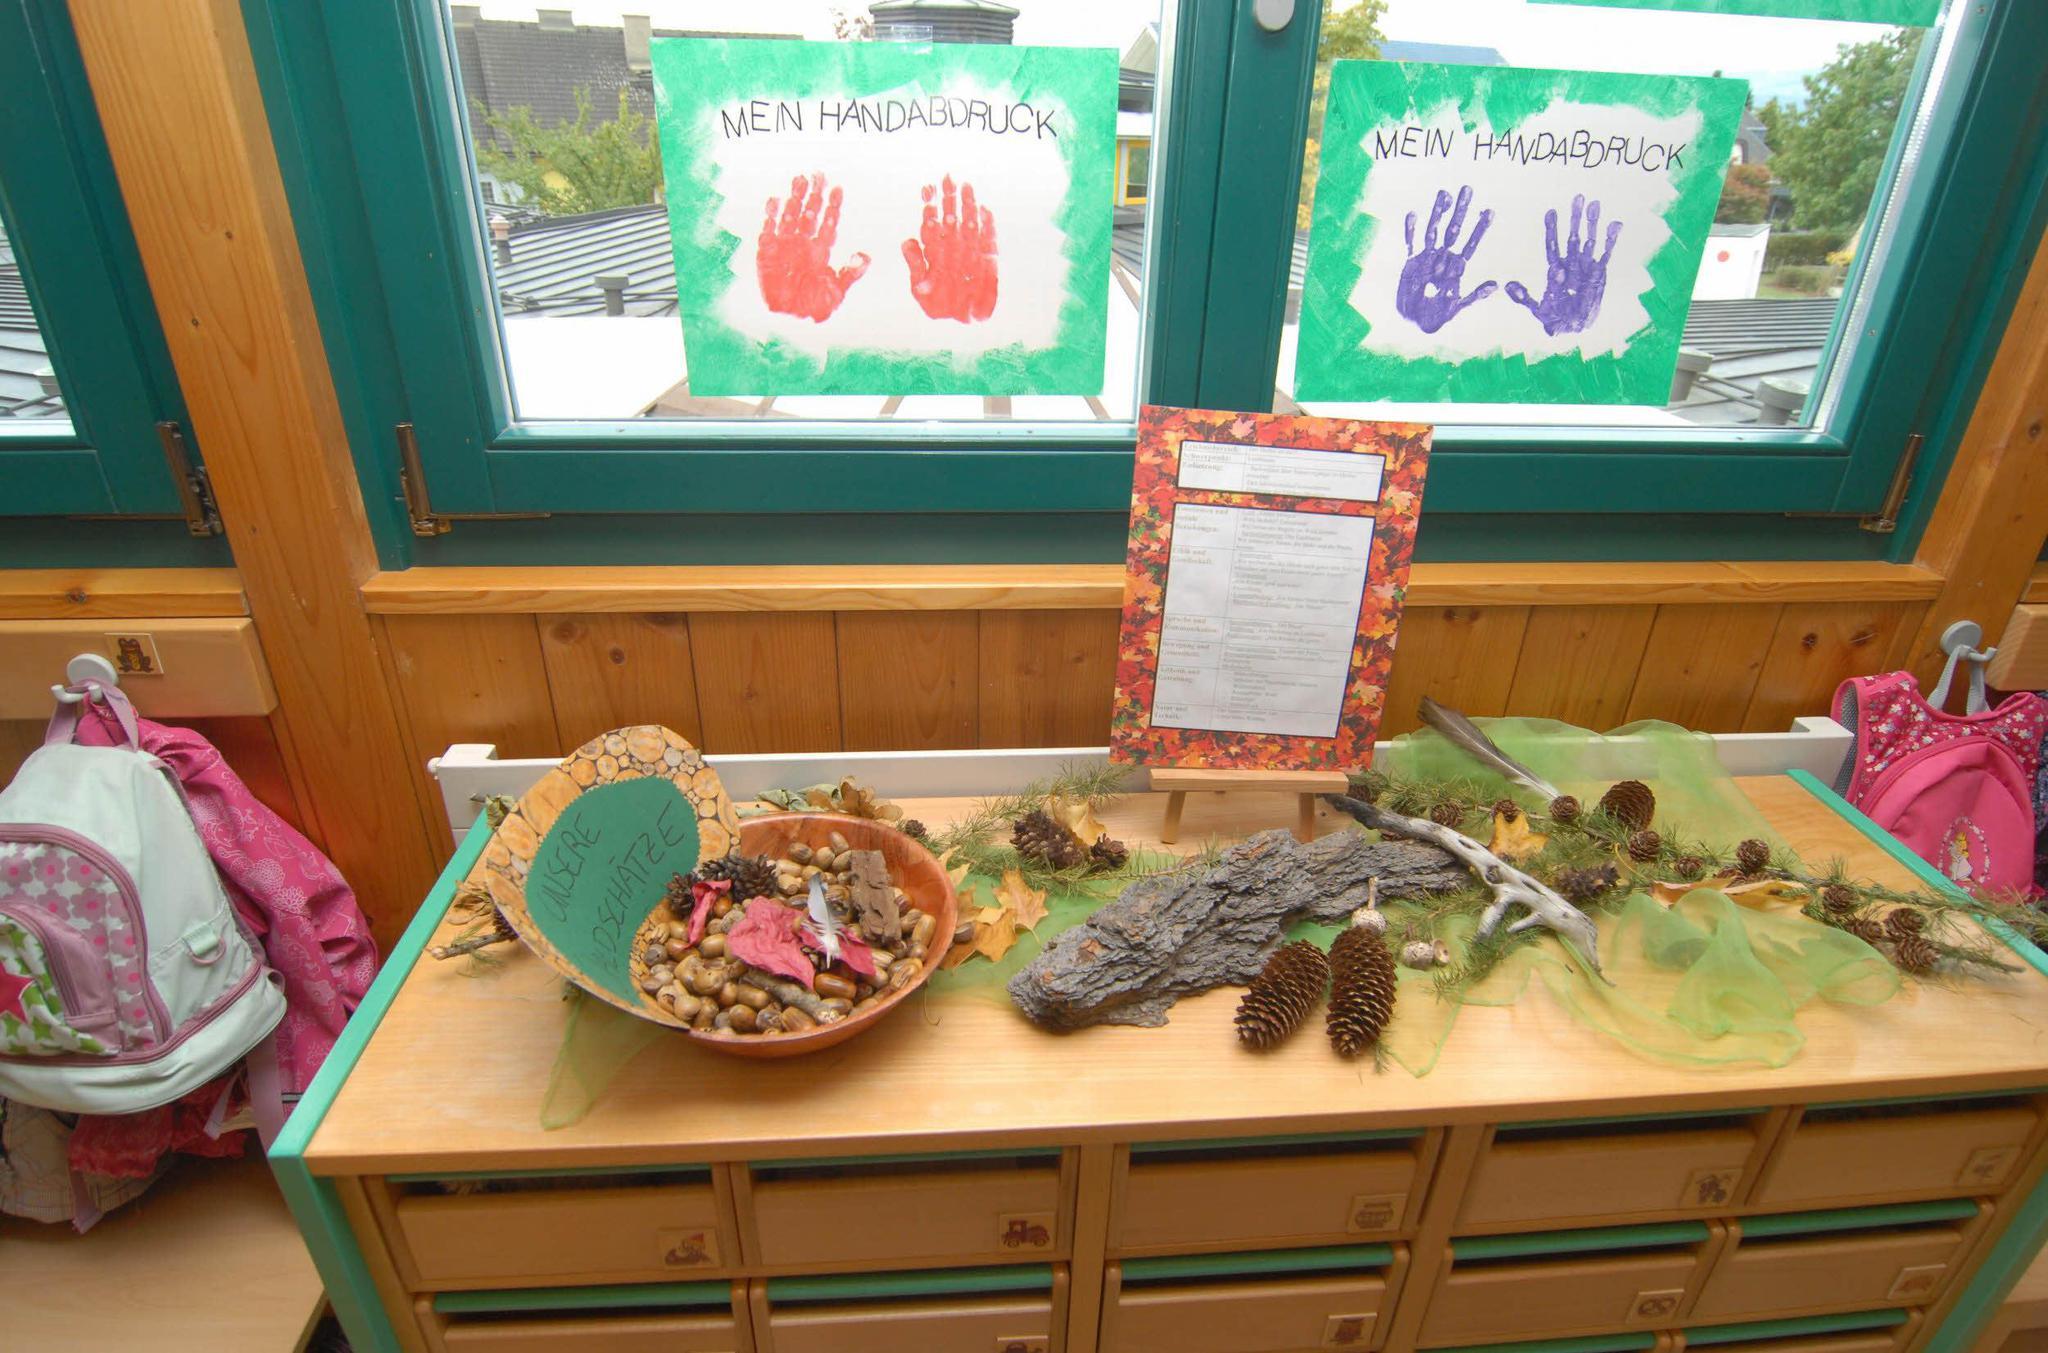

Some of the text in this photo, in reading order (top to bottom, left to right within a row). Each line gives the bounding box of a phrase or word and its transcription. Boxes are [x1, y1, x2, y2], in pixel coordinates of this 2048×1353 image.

[722, 95, 1058, 140] MEIN HANDABDRUCK
[1375, 127, 1687, 172] MEIN HANDABDRUCK
[542, 812, 602, 923] UNSERE
